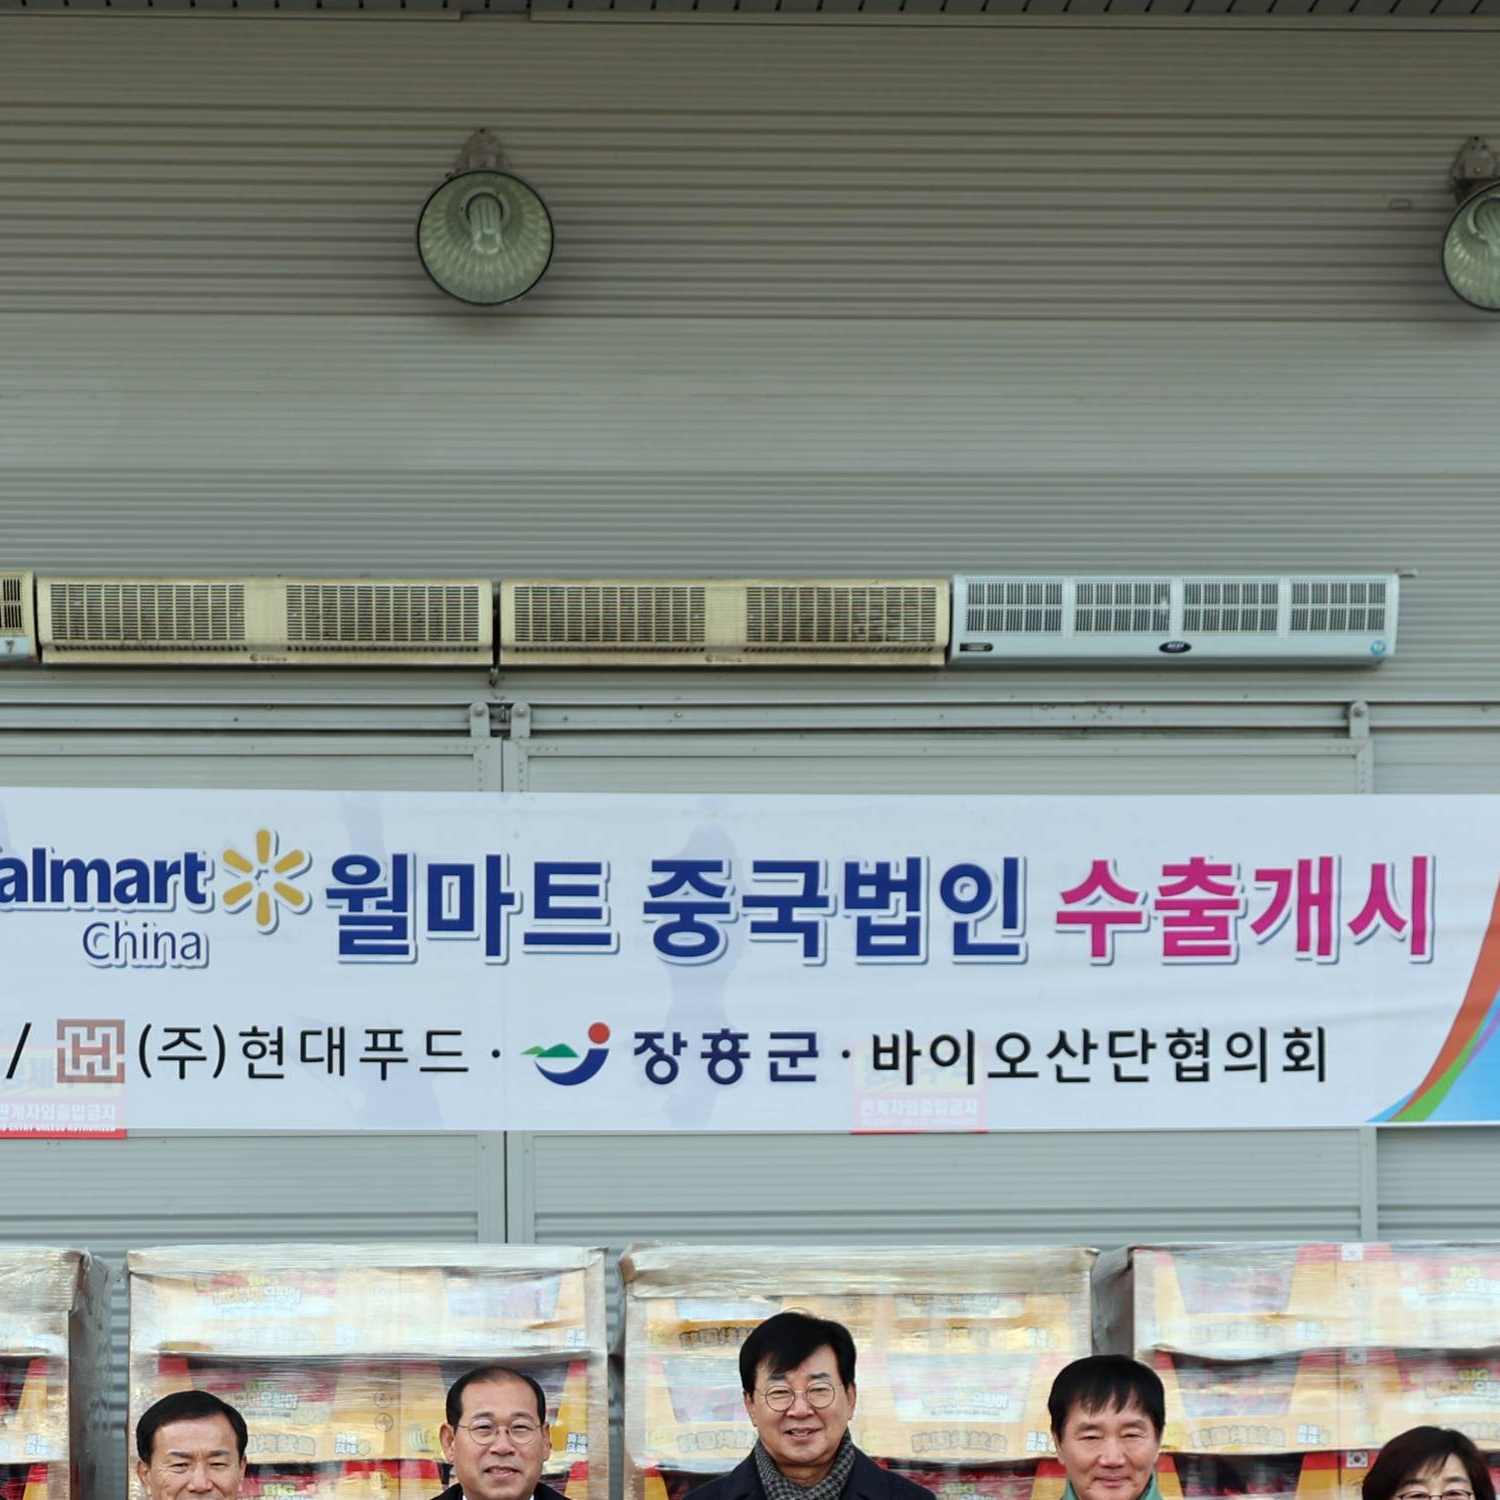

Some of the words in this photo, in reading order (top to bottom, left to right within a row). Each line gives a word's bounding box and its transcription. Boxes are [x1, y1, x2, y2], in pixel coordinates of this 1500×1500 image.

[325, 853, 614, 958] 월마트
[642, 856, 1023, 960] 중국법인
[1055, 855, 1430, 960] 수출개시
[81, 922, 204, 961] China
[633, 1029, 820, 1085] 장흥군
[871, 1026, 1327, 1086] 바이오산단협의회
